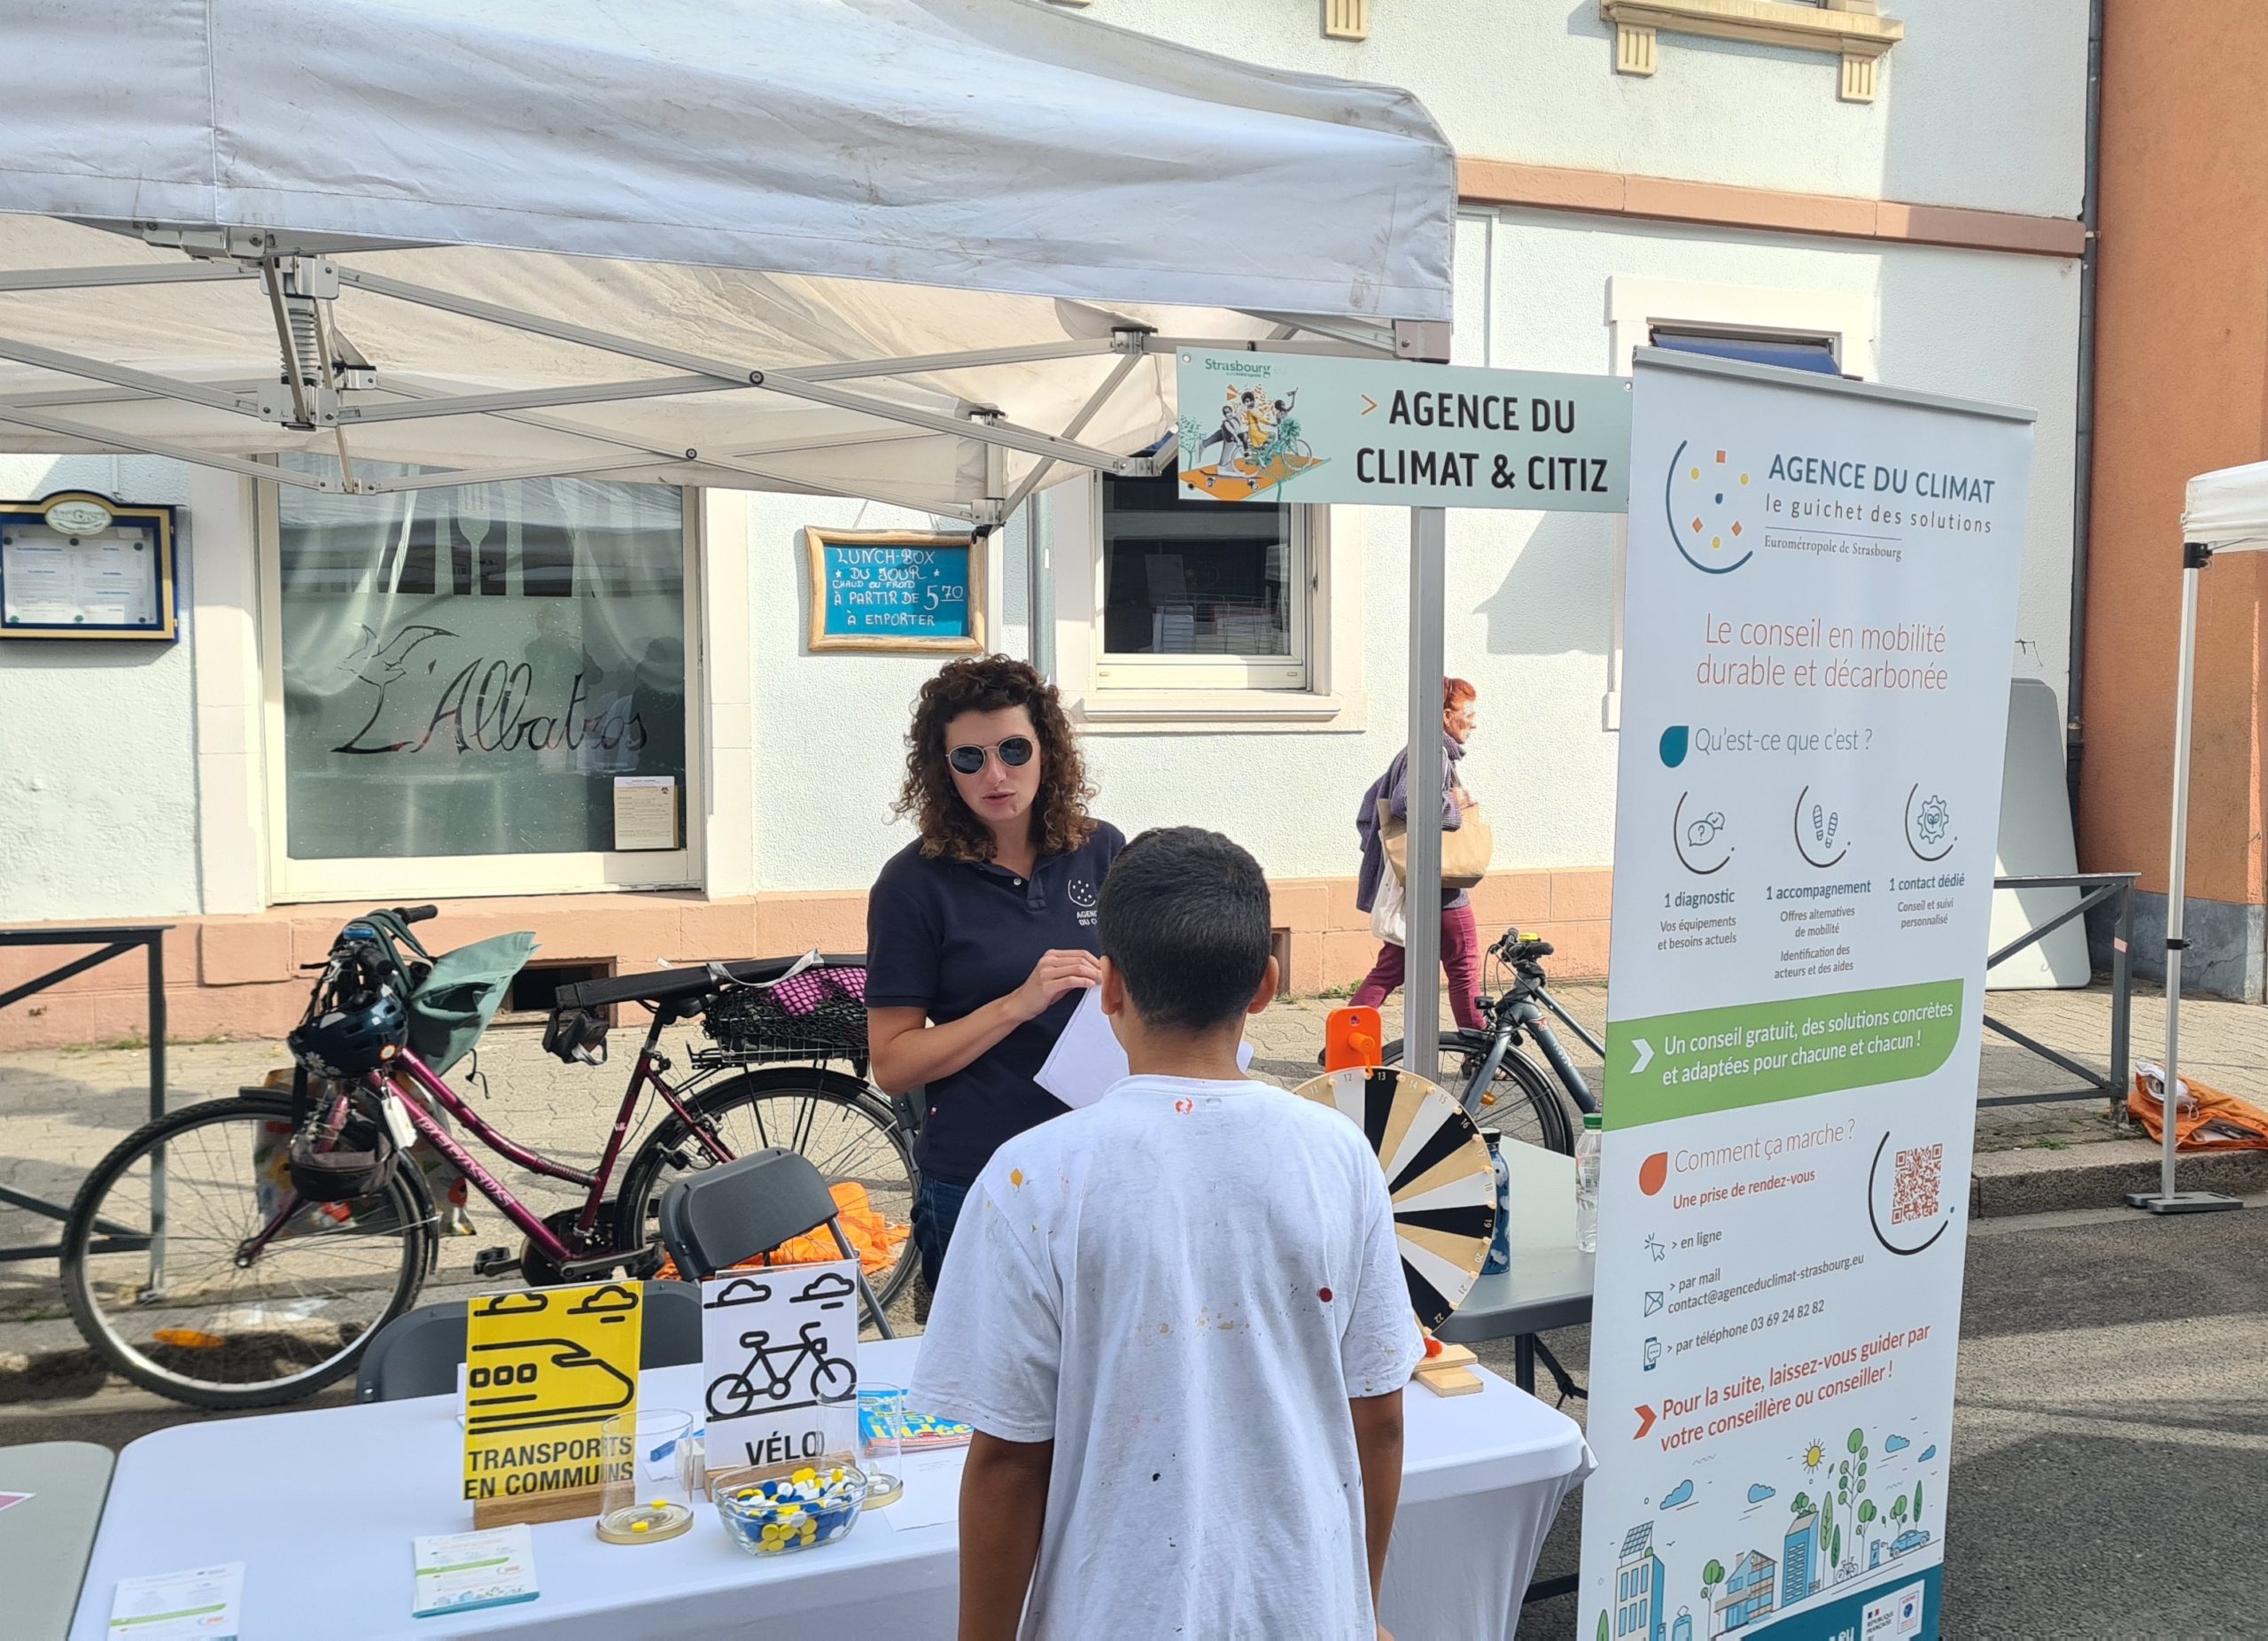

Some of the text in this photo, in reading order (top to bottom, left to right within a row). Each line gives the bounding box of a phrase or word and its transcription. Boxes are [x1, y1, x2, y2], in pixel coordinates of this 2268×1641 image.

[1205, 358, 1270, 377] Strasbourg
[1389, 389, 1575, 433] AGENCE DU
[1356, 447, 1608, 492] CLIMAT & CITIZ
[1768, 454, 1995, 503] AGENCE DU CLIMAT
[1765, 493, 1992, 533] le guichet des solutions
[836, 548, 935, 564] LUNCH-BOX
[1764, 535, 1902, 562] Eurométropole de Strasbourg
[850, 565, 927, 581] DU JOUR
[833, 579, 863, 588] CHAUD
[886, 579, 915, 588] FROID
[835, 591, 842, 606] À
[850, 592, 897, 605] PARTIR
[902, 593, 919, 604] DE
[847, 611, 935, 626] À EMPORTER
[1705, 613, 1946, 652] Le conseil en mobilité
[1697, 654, 1948, 689] durable et décarbonée
[1695, 727, 1873, 756] Qu'est-ce que c'est ?
[1766, 880, 1871, 902] 1 accompagnement
[1889, 873, 1964, 891] 1 contact dédié
[1664, 890, 1736, 907] 1 diagnostic
[1898, 898, 1953, 913] Conseil et suivi
[1076, 910, 1097, 919] AGENC
[1780, 906, 1855, 922] Offres alternatives
[1900, 914, 1948, 929] personnalisé
[1660, 915, 1736, 933] Vos équipements
[1795, 923, 1839, 937] de mobilité
[1658, 933, 1737, 950] et besoins actuels
[1781, 945, 1850, 962] Identification des
[1775, 960, 1854, 979] acteurs et des aides
[1664, 1001, 1953, 1056] Un conseil gratuit, des solutions concrètes
[1662, 1030, 1922, 1085] et adaptées pour chacune et chacun !
[1343, 1073, 1353, 1082] 12
[1377, 1071, 1386, 1081] 13
[1409, 1080, 1418, 1090] 14
[1309, 1085, 1319, 1094] 11
[1438, 1093, 1449, 1105] 15
[1460, 1118, 1471, 1130] 16
[1478, 1147, 1487, 1157] 17
[1674, 1118, 1856, 1173] Comment ça marche ?
[1673, 1169, 1816, 1209] Une prise de rendez-vous
[1484, 1218, 1493, 1228] 19
[1681, 1230, 1722, 1249] en ligne
[1474, 1252, 1484, 1264] 20
[1457, 1284, 1468, 1295] 21
[1668, 1254, 1864, 1314] contact@agenceduclimat-strasbourg.eu
[1679, 1268, 1720, 1293] par mail
[1433, 1312, 1444, 1323] 22
[1676, 1300, 1825, 1356] par téléphone 03 69 24 82 82
[1662, 1324, 1931, 1420] Pour la suite, laissez-vous guider par
[1661, 1360, 1892, 1452] votre conseillère ou conseiller !
[468, 1436, 633, 1473] TRANSPORTS
[745, 1430, 825, 1466] VÉLO
[464, 1461, 633, 1500] EN COMMUNS
